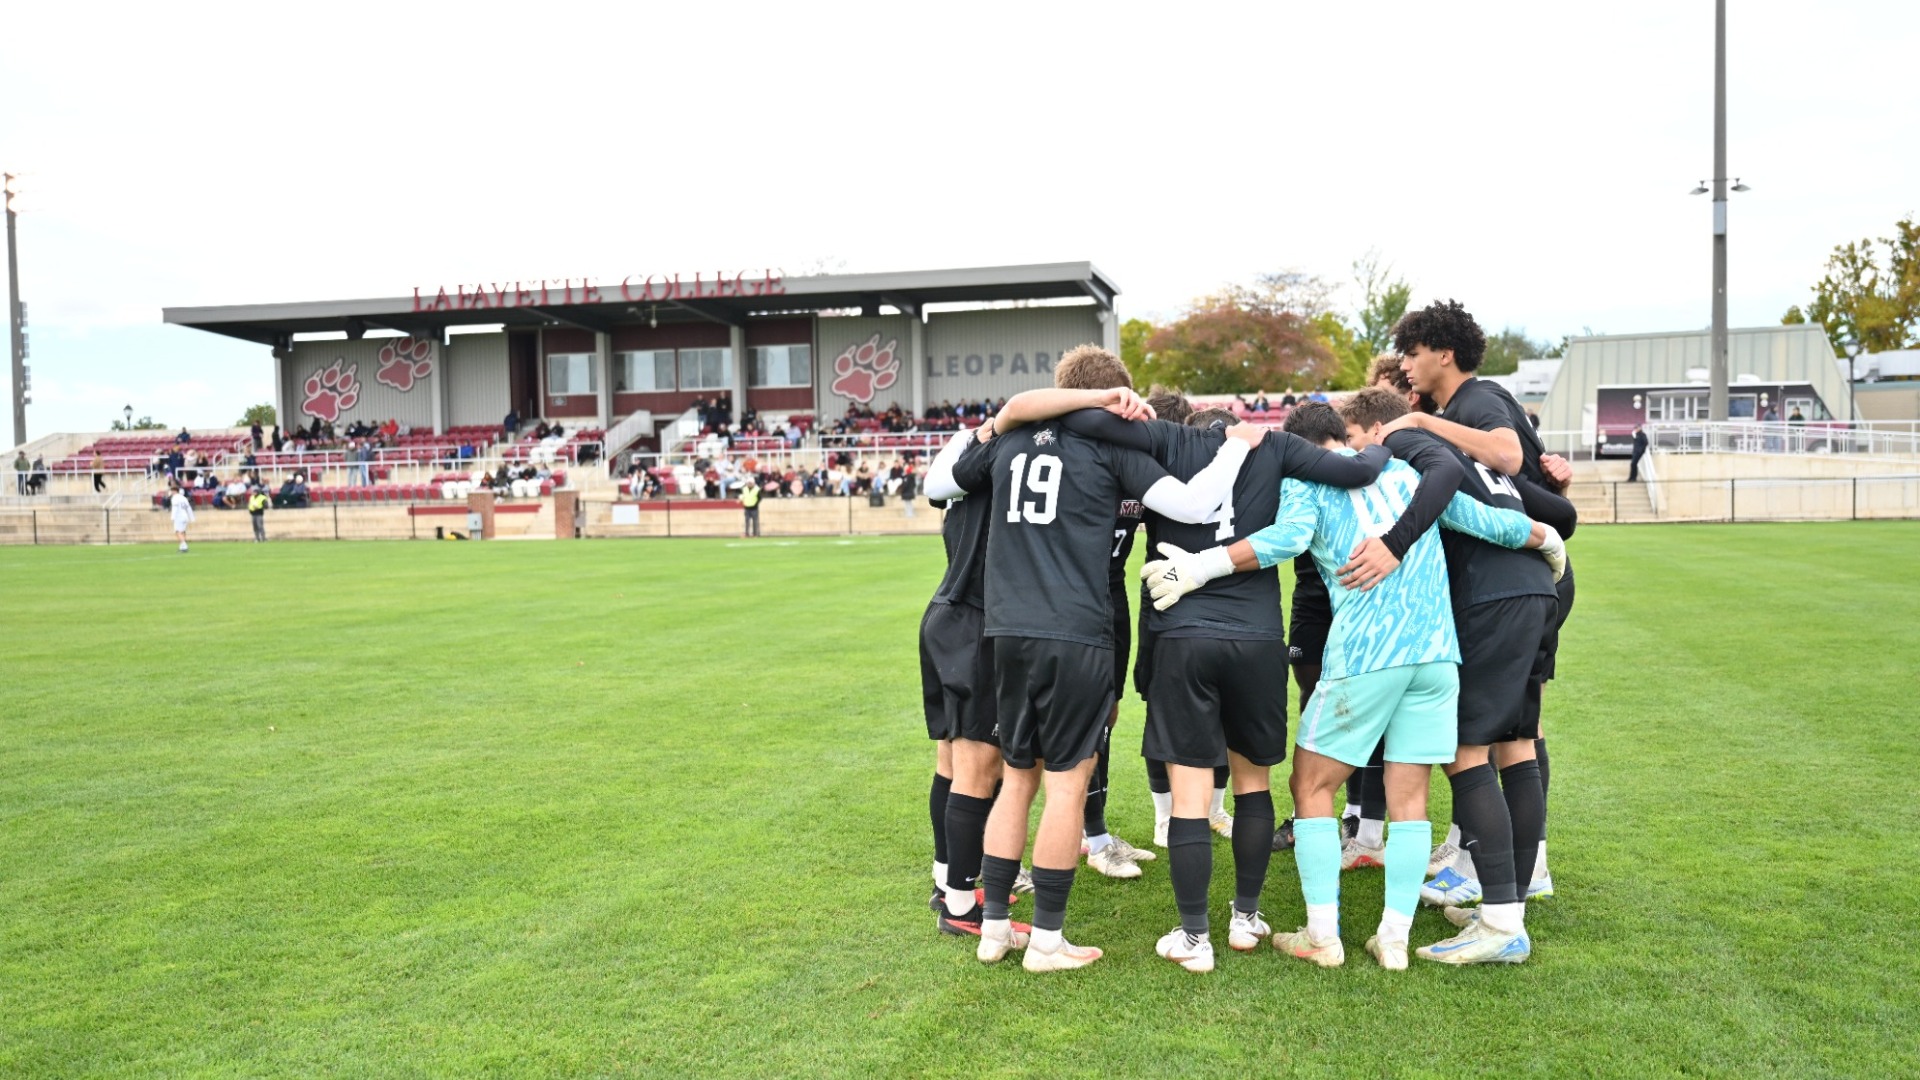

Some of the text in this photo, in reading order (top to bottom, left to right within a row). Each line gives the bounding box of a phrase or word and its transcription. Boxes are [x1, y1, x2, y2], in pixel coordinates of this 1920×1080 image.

[412, 267, 786, 313] LAFAYETTE COLLEGE
[927, 351, 1063, 378] LEOPAR
[1006, 452, 1064, 525] 19
[1111, 528, 1128, 558] 7
